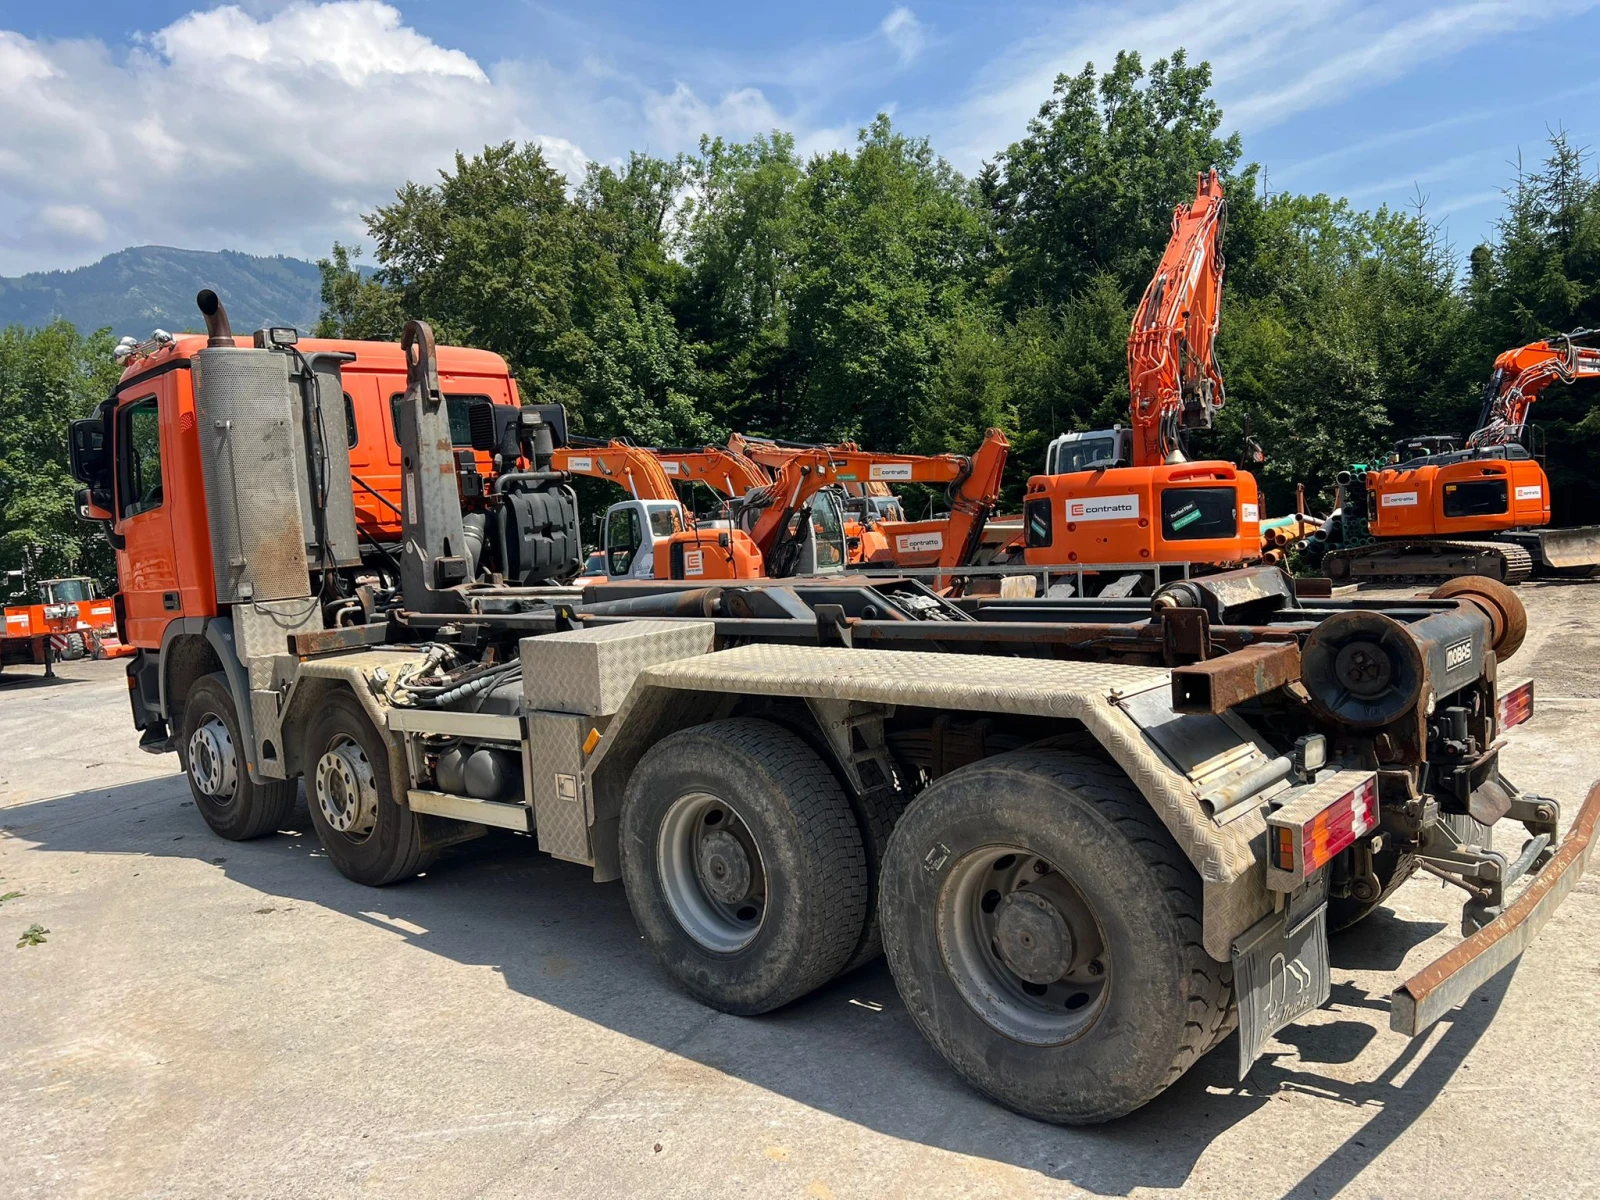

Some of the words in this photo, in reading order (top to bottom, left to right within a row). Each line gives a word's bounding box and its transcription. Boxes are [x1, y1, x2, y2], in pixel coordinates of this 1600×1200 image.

[881, 468, 908, 476] contratto
[1085, 504, 1132, 514] contratto
[909, 538, 939, 547] contratto
